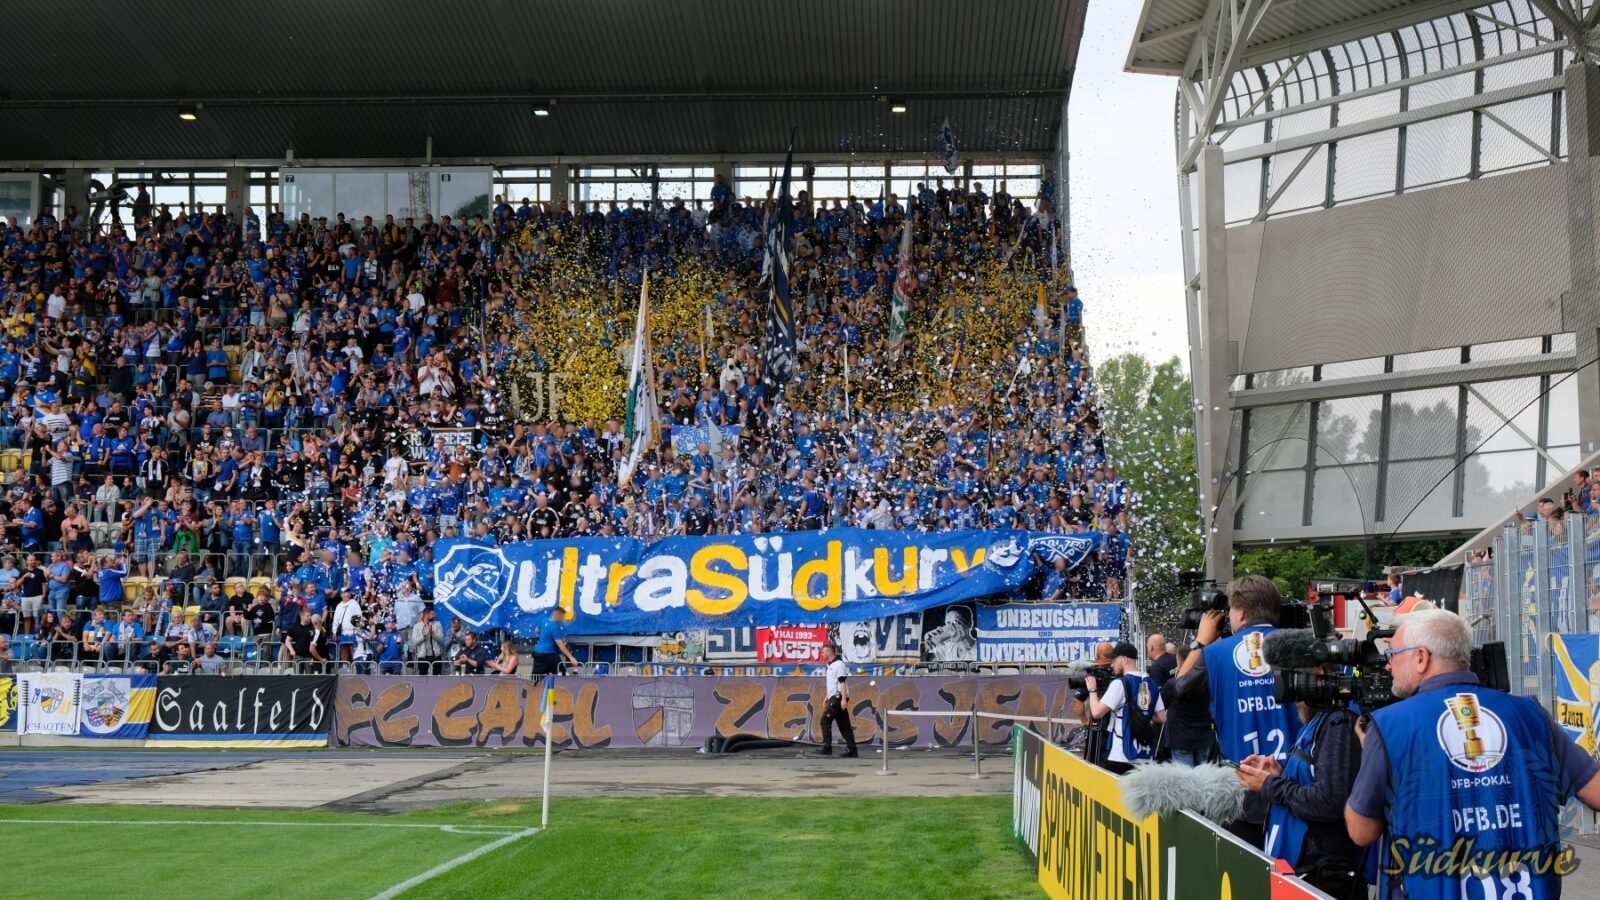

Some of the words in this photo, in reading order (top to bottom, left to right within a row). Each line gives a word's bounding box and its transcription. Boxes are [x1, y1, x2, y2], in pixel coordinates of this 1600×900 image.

[996, 608, 1099, 628] UNBEUGSAM
[979, 639, 1098, 662] UNVERKÄUFLI
[1239, 677, 1275, 688] DFB-POKA
[155, 686, 324, 734] Saalfeld
[334, 678, 420, 748] FC
[432, 680, 611, 748] CARL
[27, 721, 74, 732] CHAOTEN
[1243, 728, 1287, 760] 12
[1451, 775, 1512, 790] DFB-POKAL
[1452, 803, 1522, 833] DFB.DE
